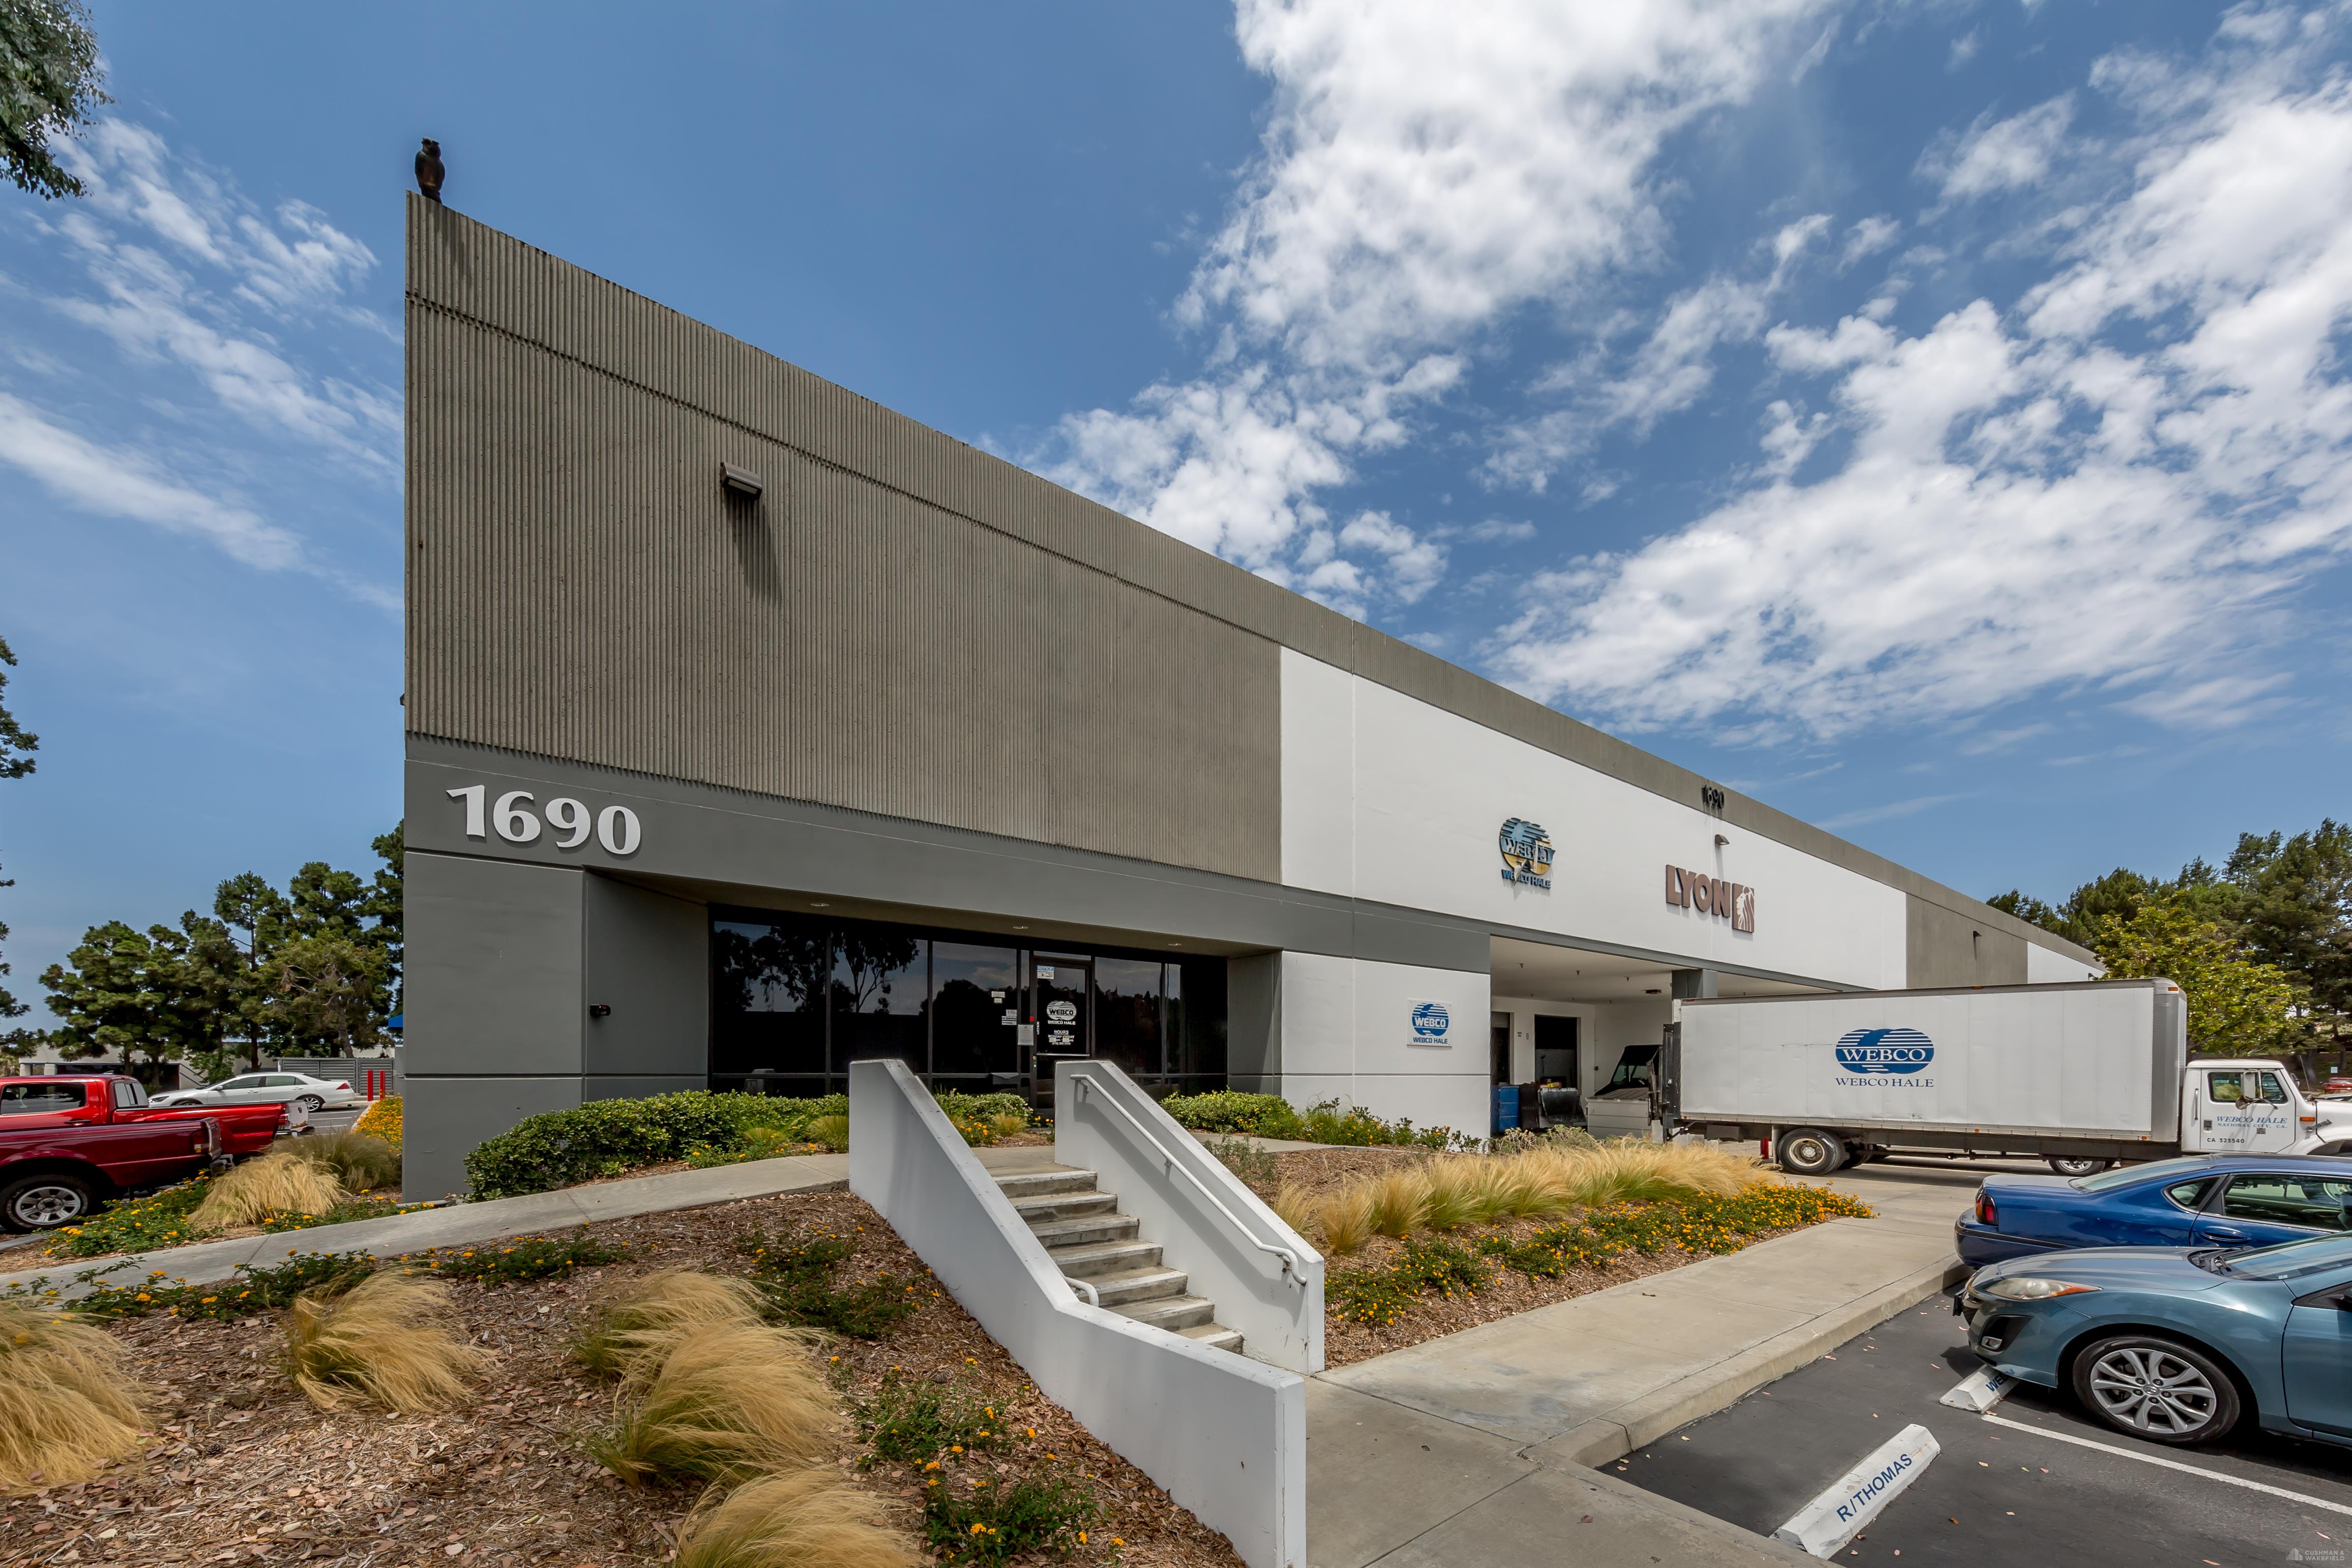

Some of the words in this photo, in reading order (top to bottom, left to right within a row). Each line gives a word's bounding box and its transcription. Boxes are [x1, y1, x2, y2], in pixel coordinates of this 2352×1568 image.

[1701, 784, 1724, 809] 1690
[446, 784, 641, 854] 1690
[1530, 875, 1551, 889] HALE
[1666, 864, 1730, 918] LYON
[1415, 1017, 1446, 1028] WEBCO
[1842, 1048, 1926, 1061] WEBCO
[1835, 1078, 1888, 1087] WEBCO
[1892, 1079, 1934, 1087] HALE
[1837, 1453, 1913, 1523] R/THOMAS
